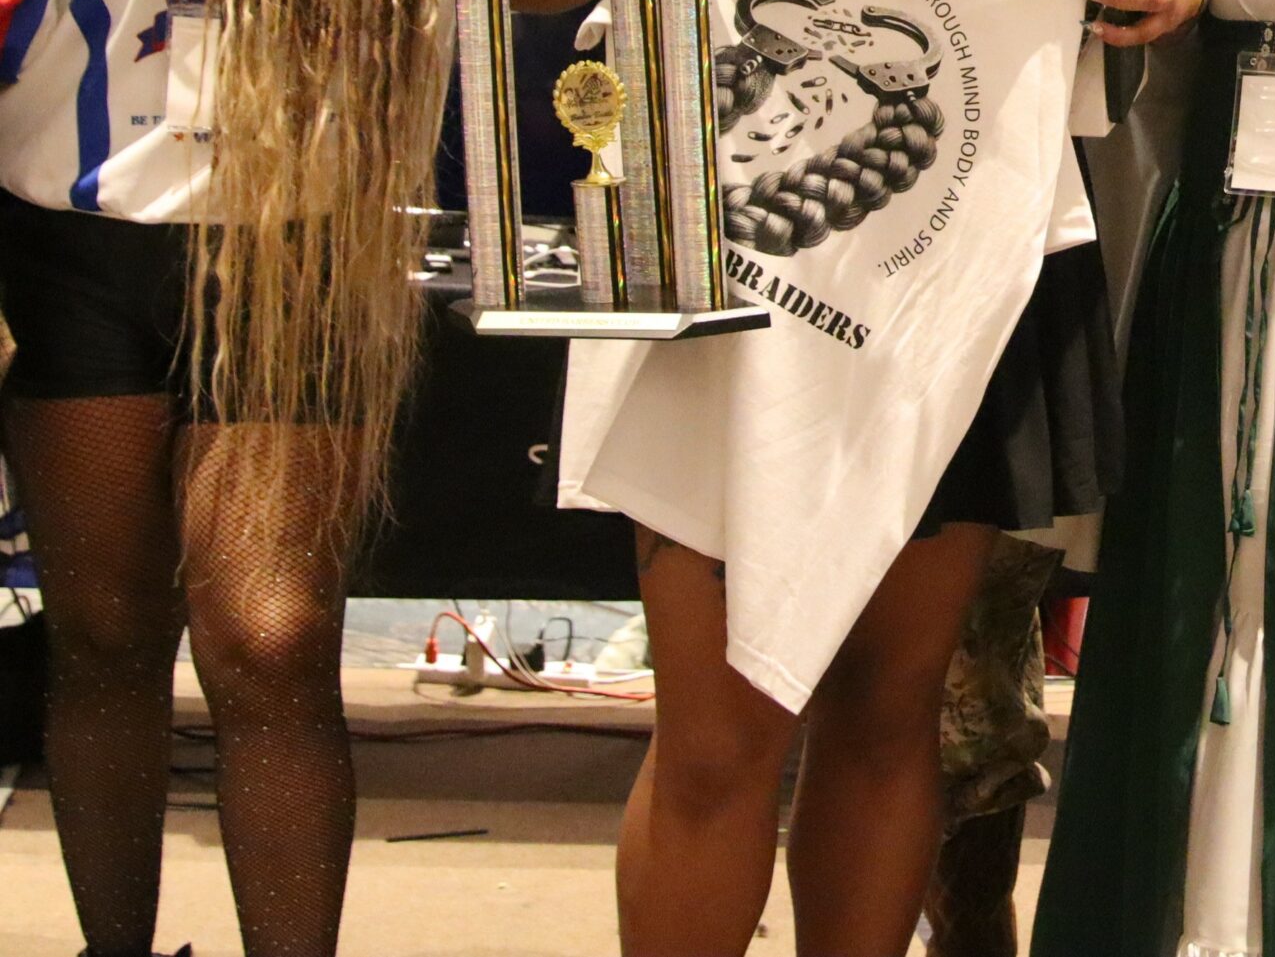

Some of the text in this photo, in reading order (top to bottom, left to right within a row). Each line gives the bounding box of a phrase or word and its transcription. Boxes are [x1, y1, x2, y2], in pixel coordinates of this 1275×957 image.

[959, 66, 981, 123] MIND
[953, 129, 980, 187] BODY
[929, 187, 960, 232] AND
[877, 229, 933, 279] SPIRIT.
[725, 249, 872, 350] BRAIDERS
